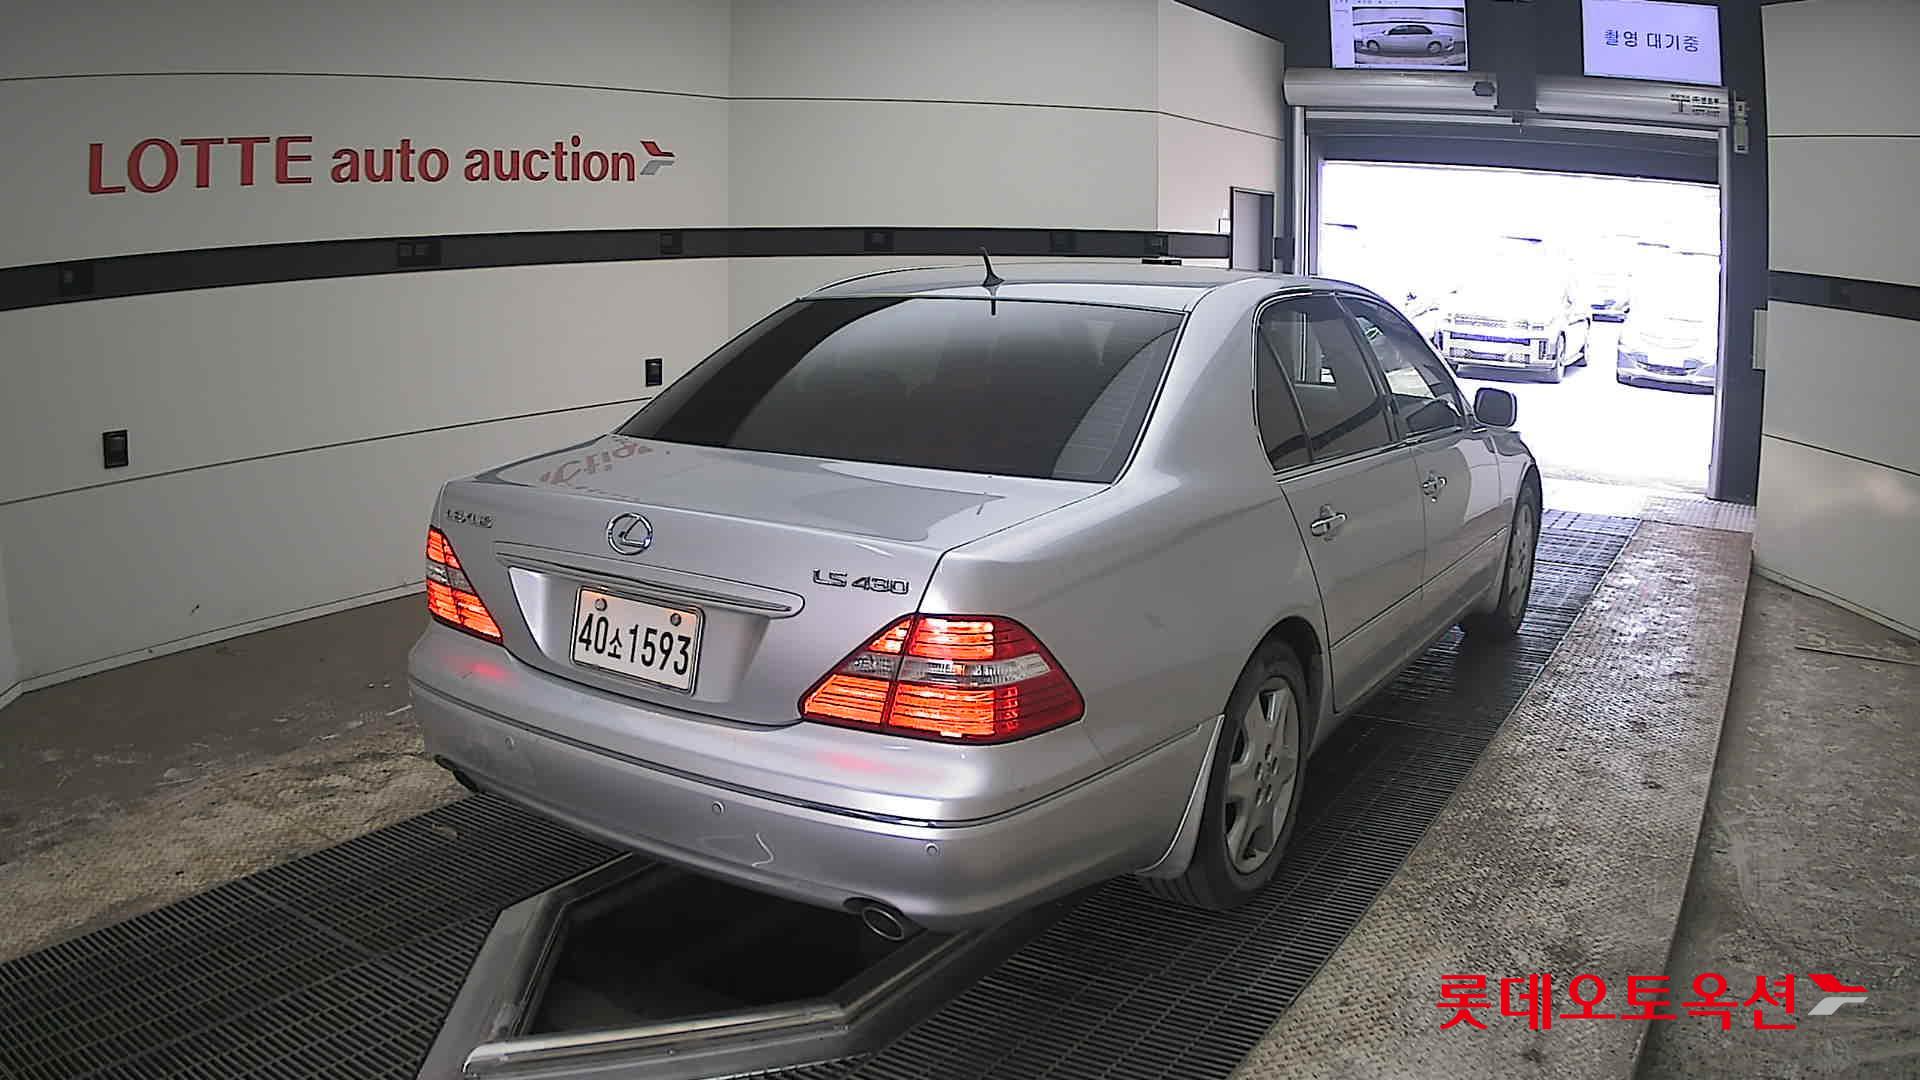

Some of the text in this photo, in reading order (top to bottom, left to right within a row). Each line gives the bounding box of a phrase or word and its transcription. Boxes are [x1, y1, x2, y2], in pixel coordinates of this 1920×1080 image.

[1604, 29, 1700, 53] 촬영 대기중
[88, 134, 636, 195] LOTTE auto auction
[812, 568, 910, 595] LS 430
[577, 612, 692, 676] 40소1593
